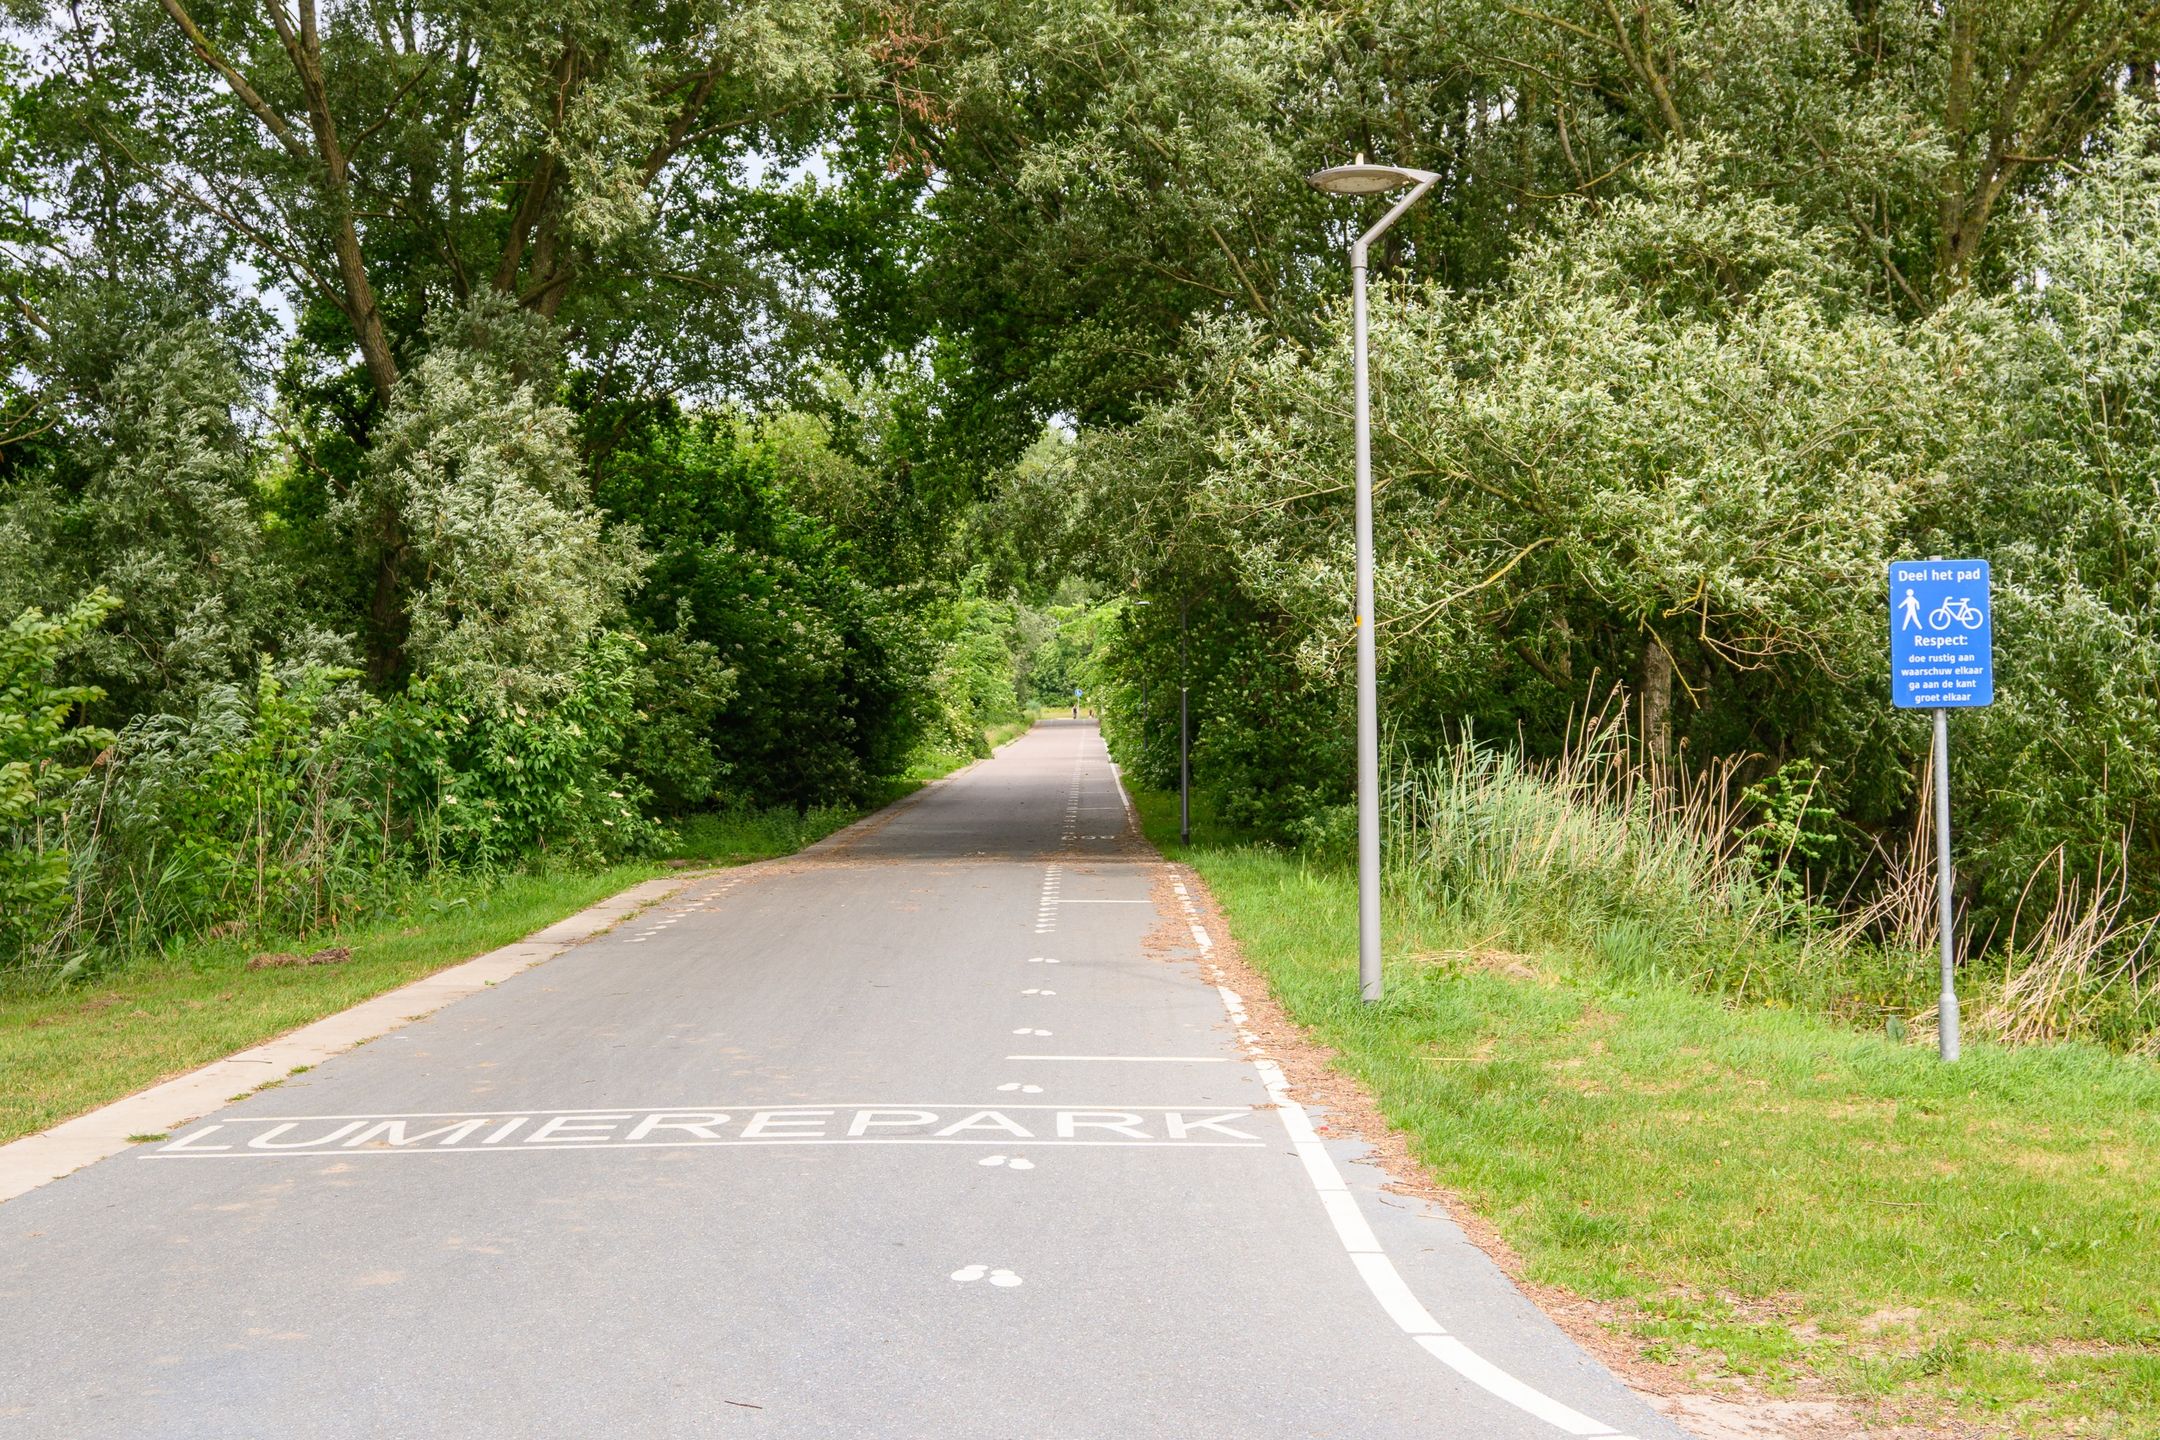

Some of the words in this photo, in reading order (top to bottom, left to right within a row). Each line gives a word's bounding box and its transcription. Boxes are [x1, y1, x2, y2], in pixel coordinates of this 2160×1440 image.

[1898, 569, 1927, 582] Deel
[1932, 569, 1952, 581] het
[1957, 568, 1980, 583] pad
[1914, 634, 1968, 648] Respect:
[1909, 654, 1926, 663] doe
[1928, 653, 1956, 664] rustig
[1958, 654, 1975, 662] aan
[1901, 667, 1952, 676] waarschuw
[1955, 666, 1983, 674] elkaar
[1909, 682, 1920, 692] ga
[1923, 681, 1939, 689] aan
[1942, 680, 1954, 689] de
[1956, 679, 1976, 688] kant
[1915, 695, 1940, 705] groet
[1943, 694, 1971, 702] elkaar
[157, 1110, 1262, 1152] LUMIEREPARK
